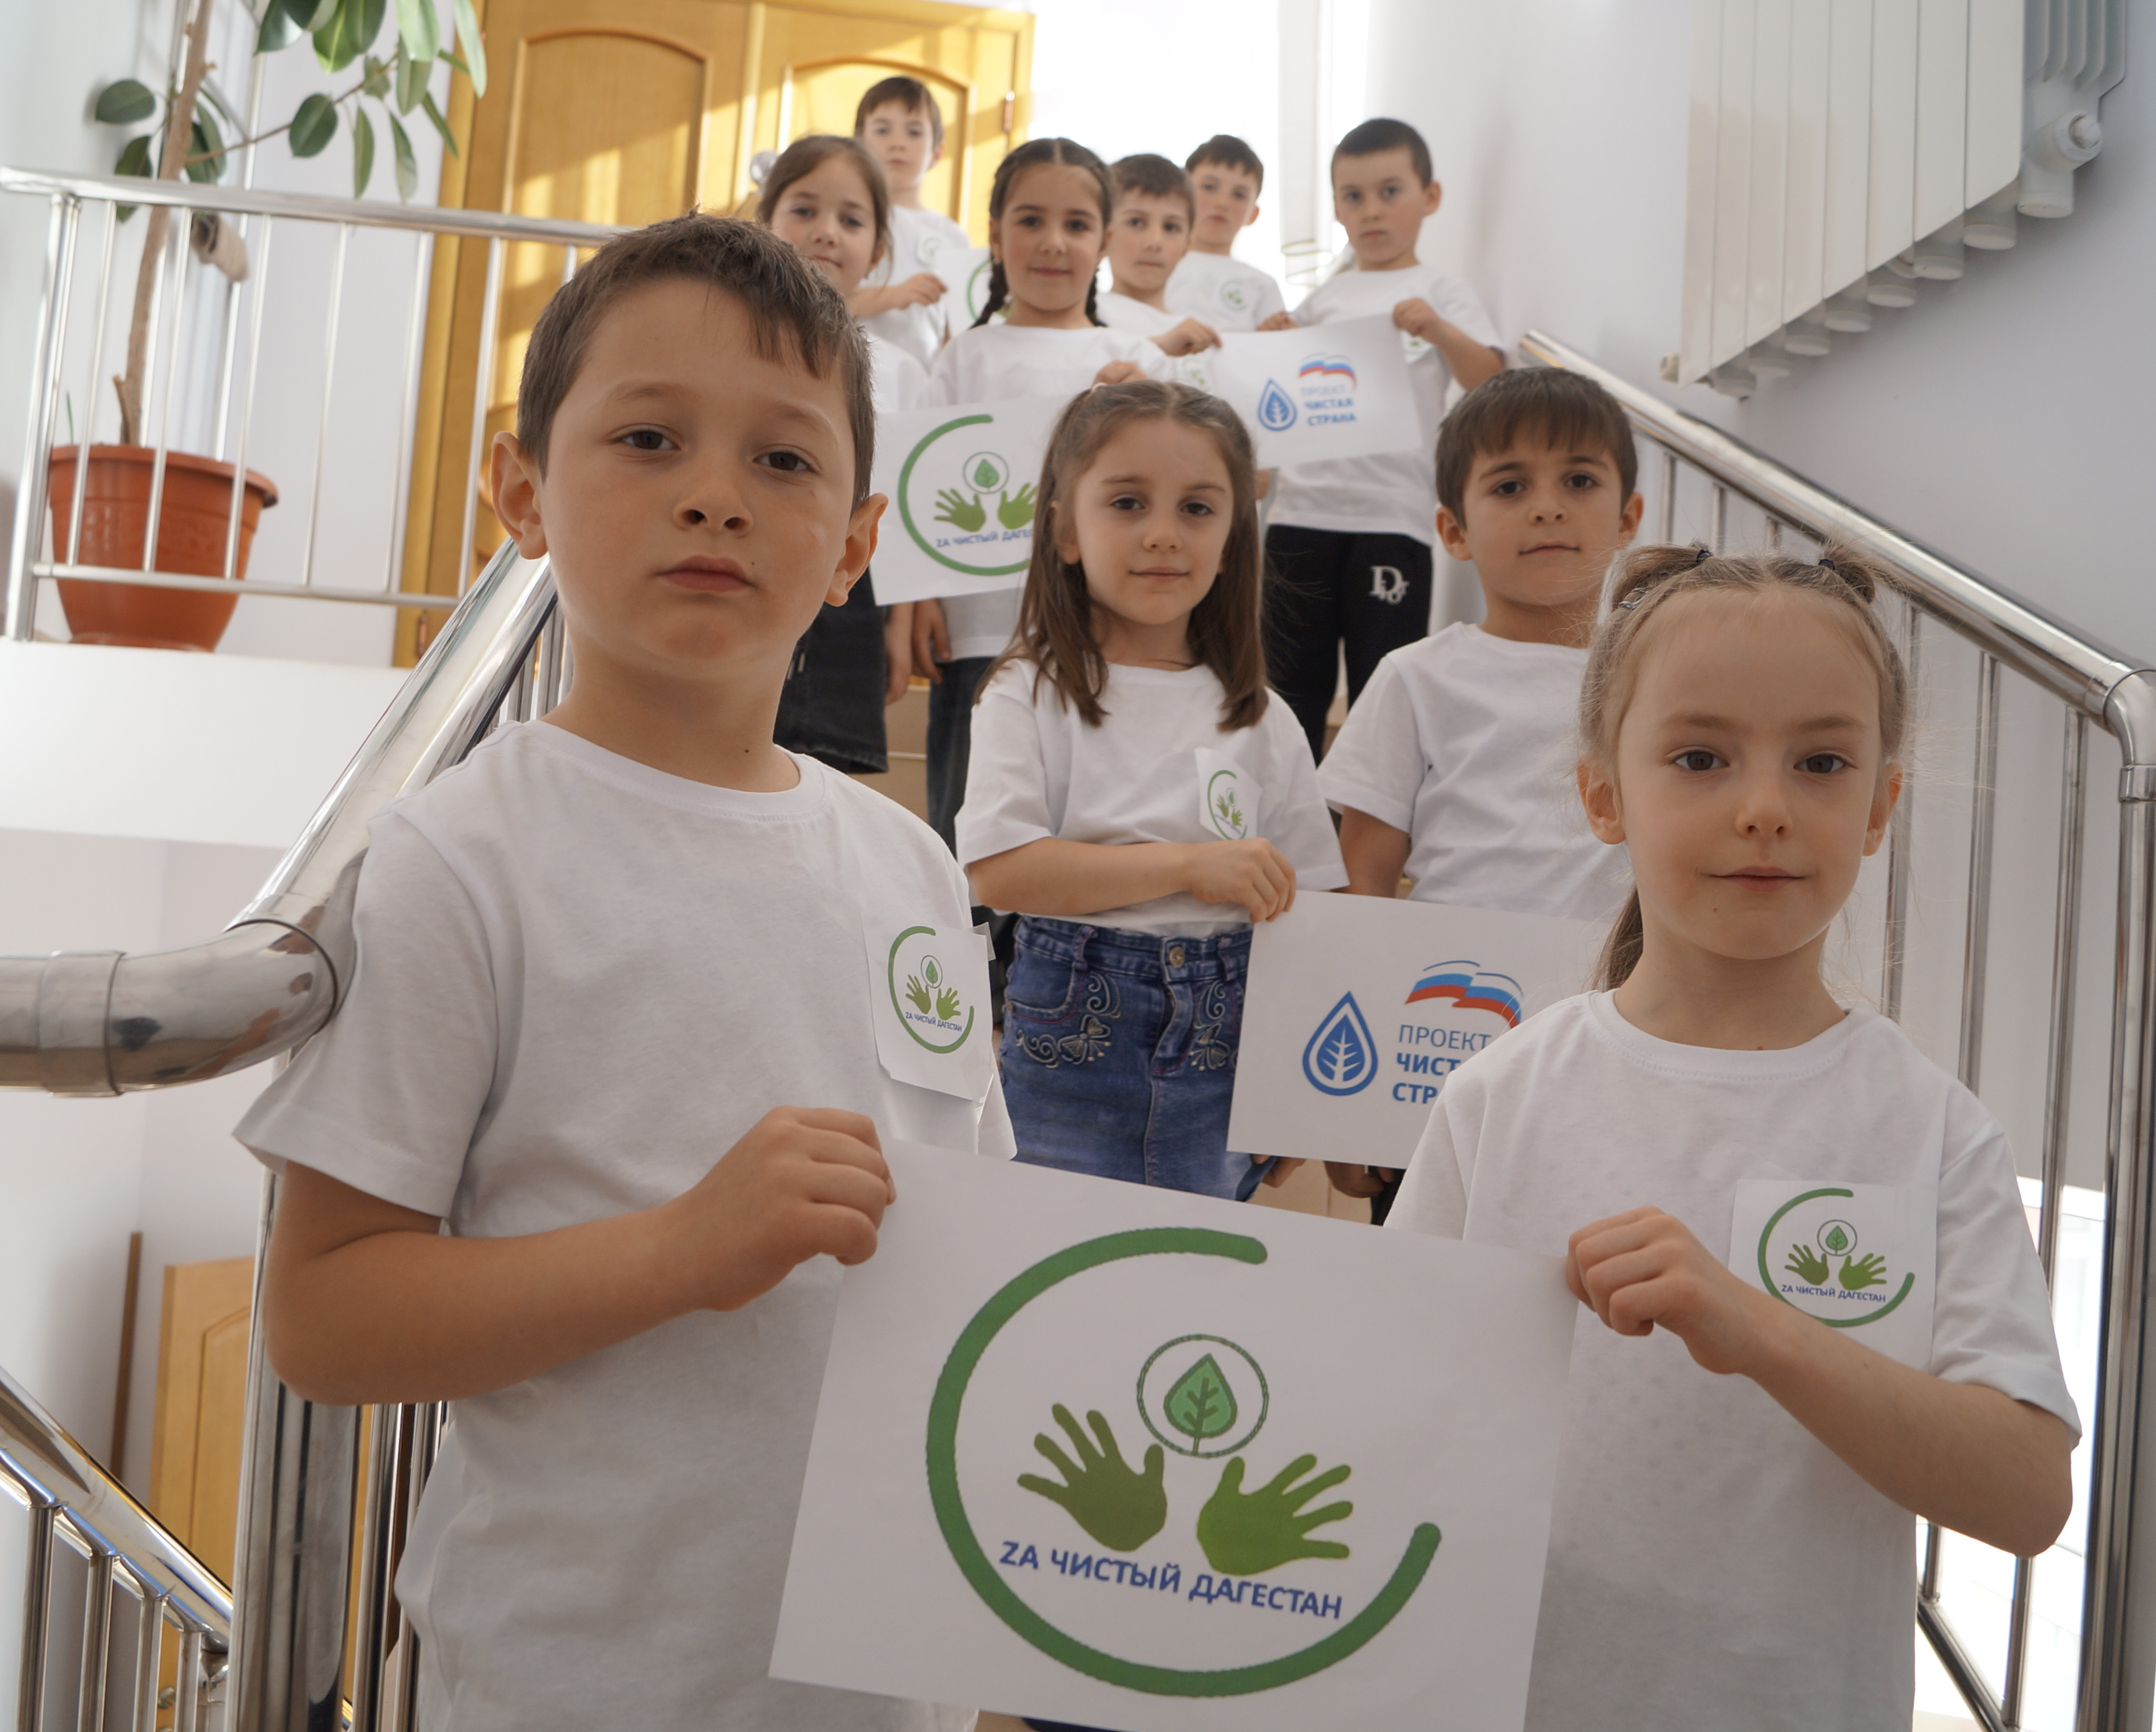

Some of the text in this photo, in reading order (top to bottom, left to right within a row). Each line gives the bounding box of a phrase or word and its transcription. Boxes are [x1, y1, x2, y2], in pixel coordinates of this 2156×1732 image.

[1304, 397, 1354, 410] ЧИСТАЯ
[1307, 412, 1356, 426] СТРАНА
[952, 531, 998, 545] ЧИСТЫЙ
[1002, 528, 1034, 542] ДАГЕС
[914, 1014, 936, 1025] ЧИСТЫЙ
[937, 1020, 962, 1032] ДАГЕСТАН
[1399, 1024, 1492, 1052] ПРОЕКТ
[1396, 1052, 1462, 1076] ЧИСТ
[1392, 1082, 1438, 1105] СТР
[1796, 1286, 1836, 1297] ЧИСТЫЙ
[1838, 1290, 1886, 1303] ДАГЕСТАН
[1050, 1548, 1182, 1593] ЧИСТЫЙ
[1188, 1573, 1342, 1620] ДАГЕСТАН
